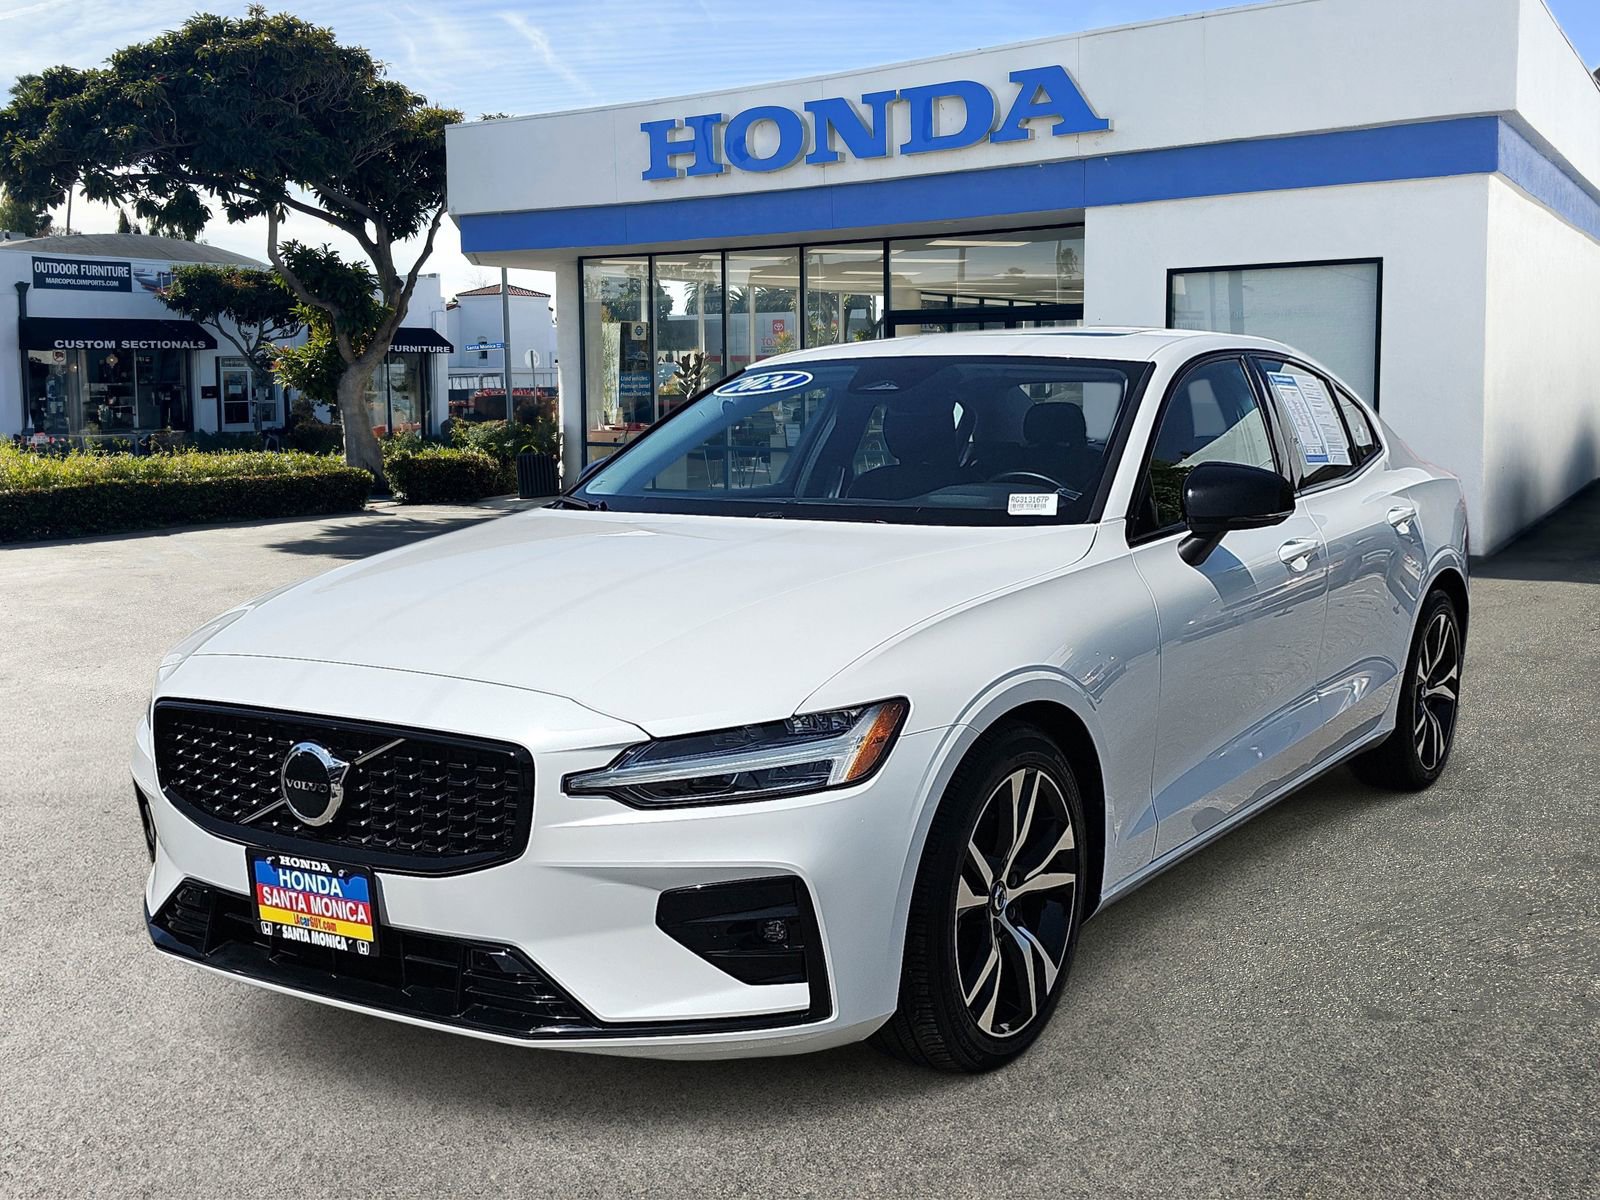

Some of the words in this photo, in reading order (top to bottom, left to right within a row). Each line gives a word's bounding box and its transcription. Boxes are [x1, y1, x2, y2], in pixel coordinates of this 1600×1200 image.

[641, 65, 1110, 181] HONDA
[34, 261, 79, 275] OUTDOOR
[81, 264, 130, 278] FURNITURE
[45, 277, 119, 287] MARCOPOLOIMPORTS.COM
[54, 339, 116, 349] CUSTOM
[121, 340, 206, 349] SECTIONALS
[388, 344, 451, 353] FURNITURE
[720, 374, 804, 393] 2024
[1010, 495, 1050, 504] RG313167P
[285, 777, 329, 793] VOLVO
[278, 855, 333, 873] HONDA
[278, 868, 343, 898] HONDA
[262, 886, 308, 913] SANTA
[309, 895, 368, 924] MONICA
[282, 925, 311, 944] SANTA
[311, 931, 348, 951] MONICA
